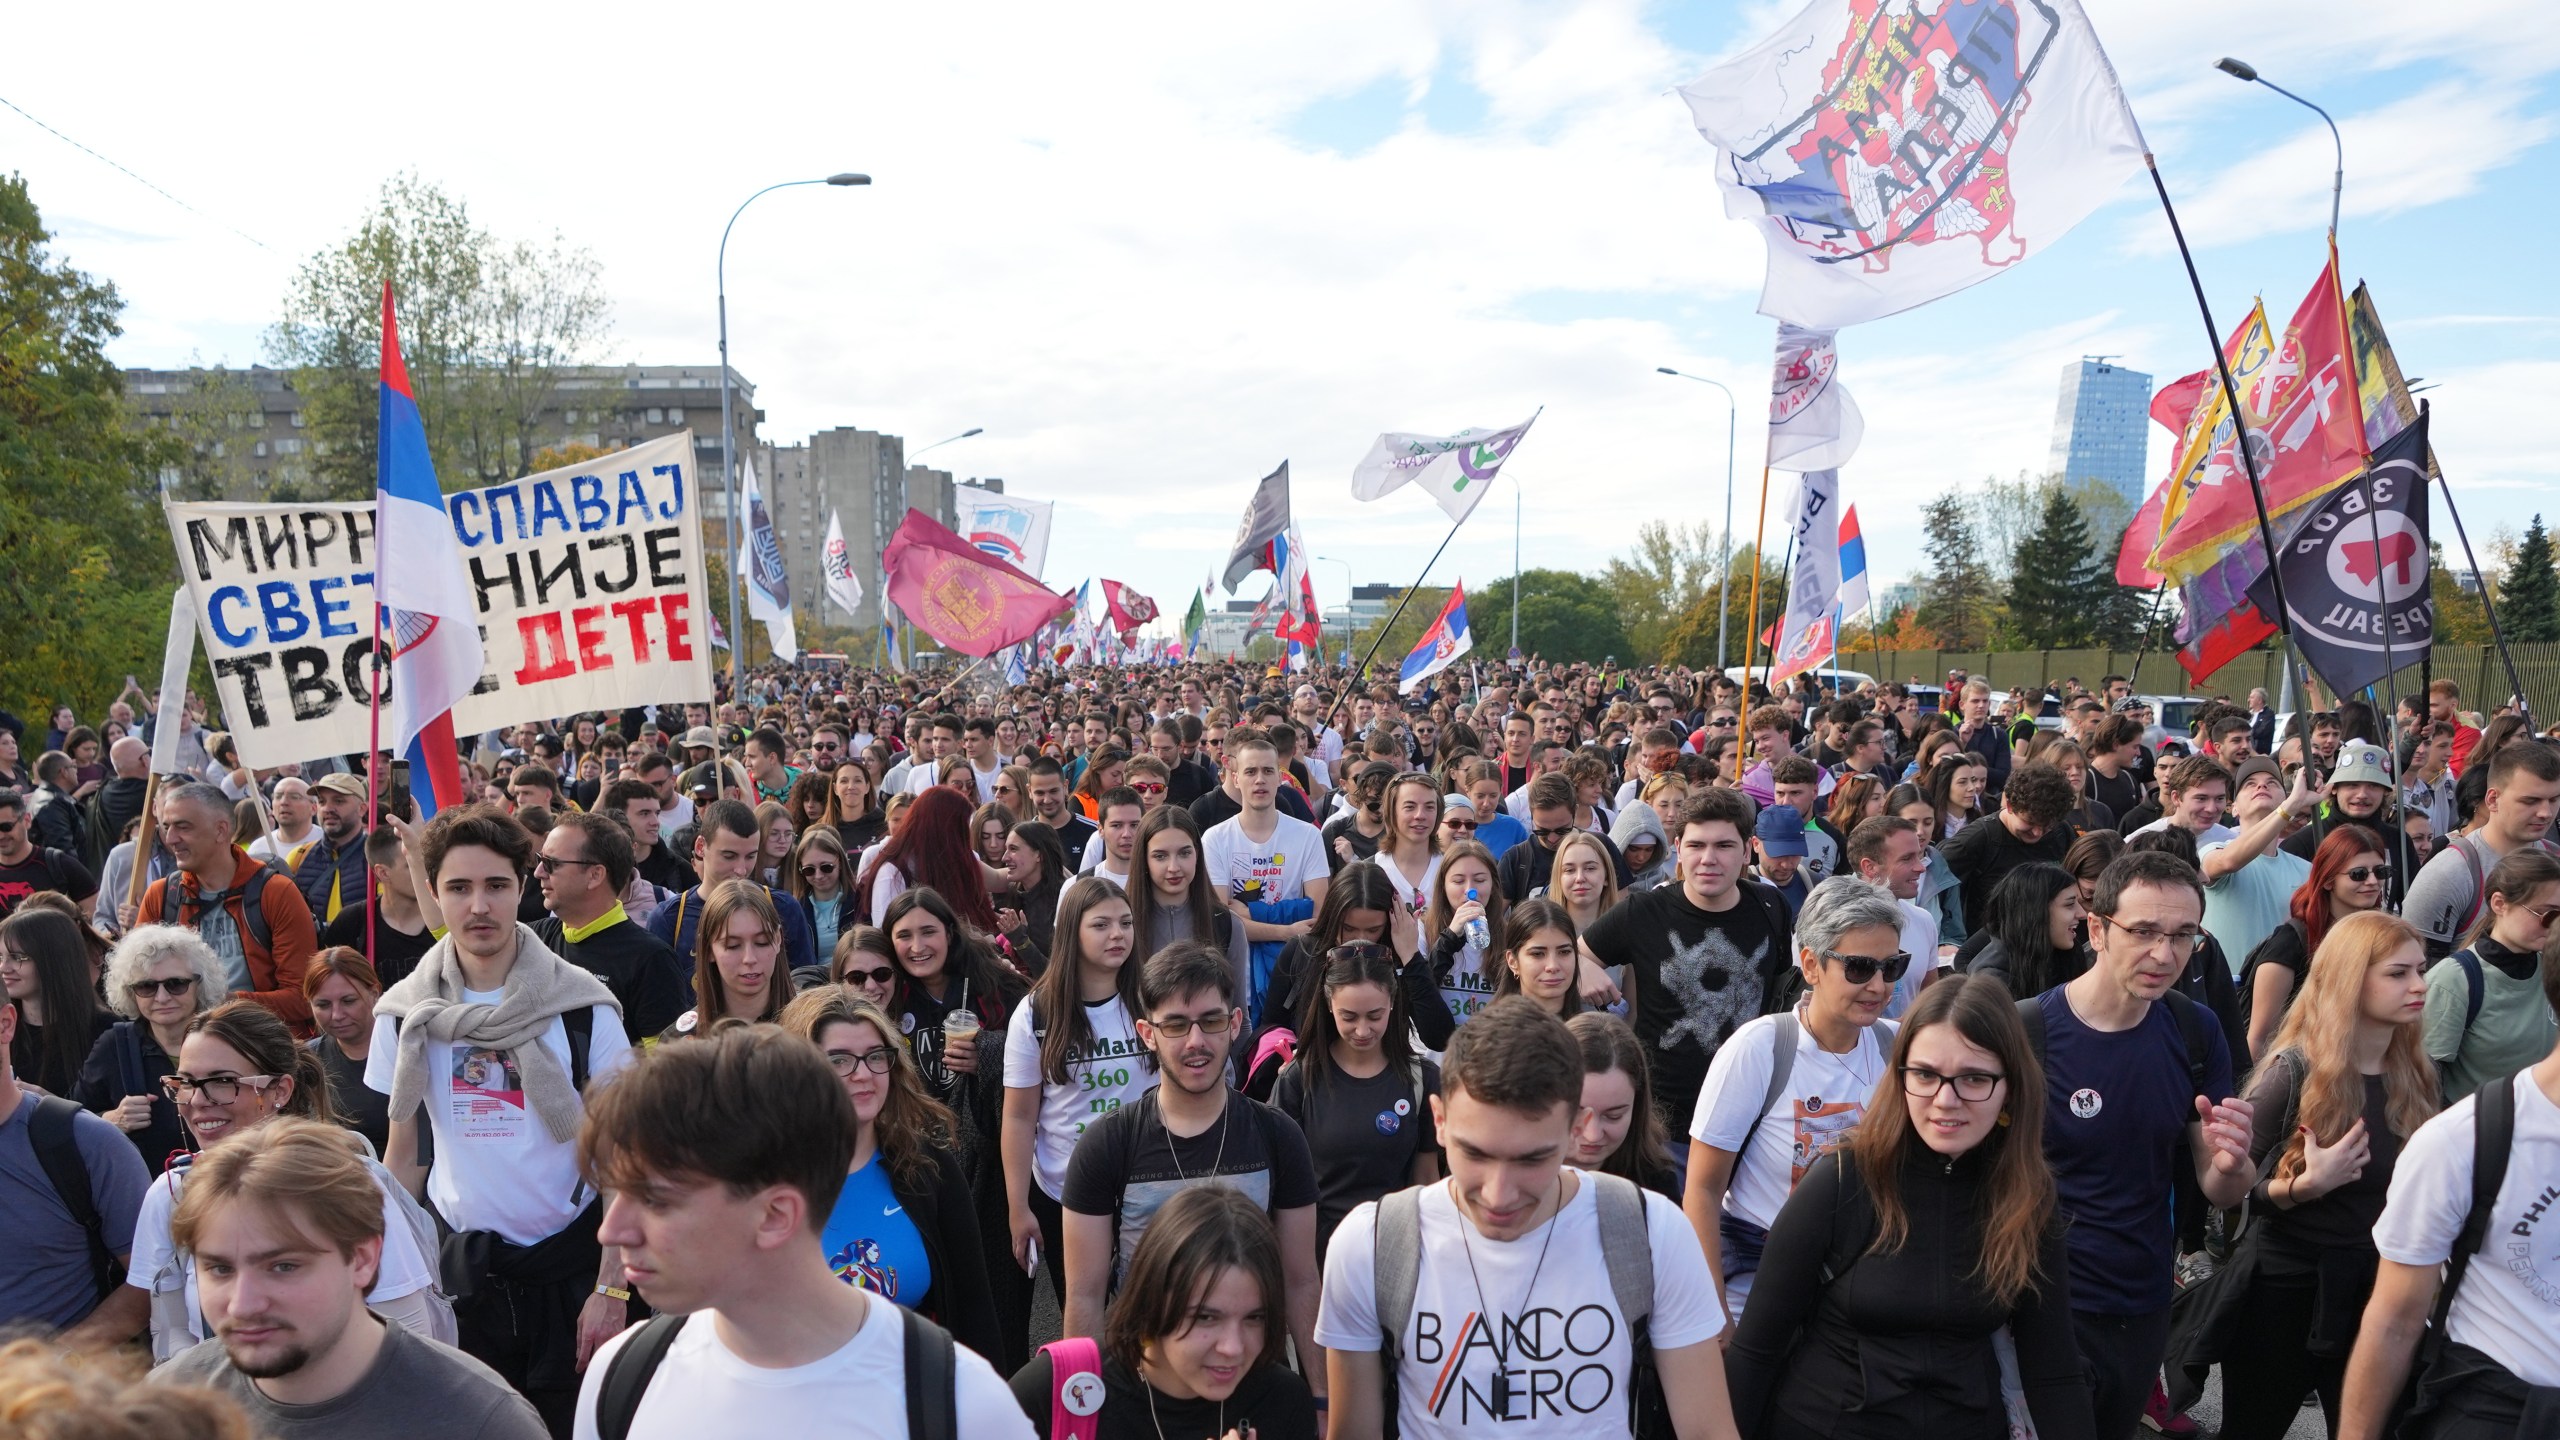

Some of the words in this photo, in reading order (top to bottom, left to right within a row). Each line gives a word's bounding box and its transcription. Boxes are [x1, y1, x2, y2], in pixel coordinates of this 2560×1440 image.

[186, 509, 377, 582] МИРН
[450, 464, 684, 547] СПАВАЈ
[469, 527, 686, 613] НИЈЕ
[514, 593, 692, 686] ДЕТЕ
[1252, 868, 1282, 877] BLOADI
[1080, 1068, 1129, 1092] 360
[1090, 1098, 1120, 1113] na
[1129, 1172, 1163, 1181] ANGING
[1416, 1304, 1614, 1388] BANCO
[1461, 1363, 1614, 1426] NERO
